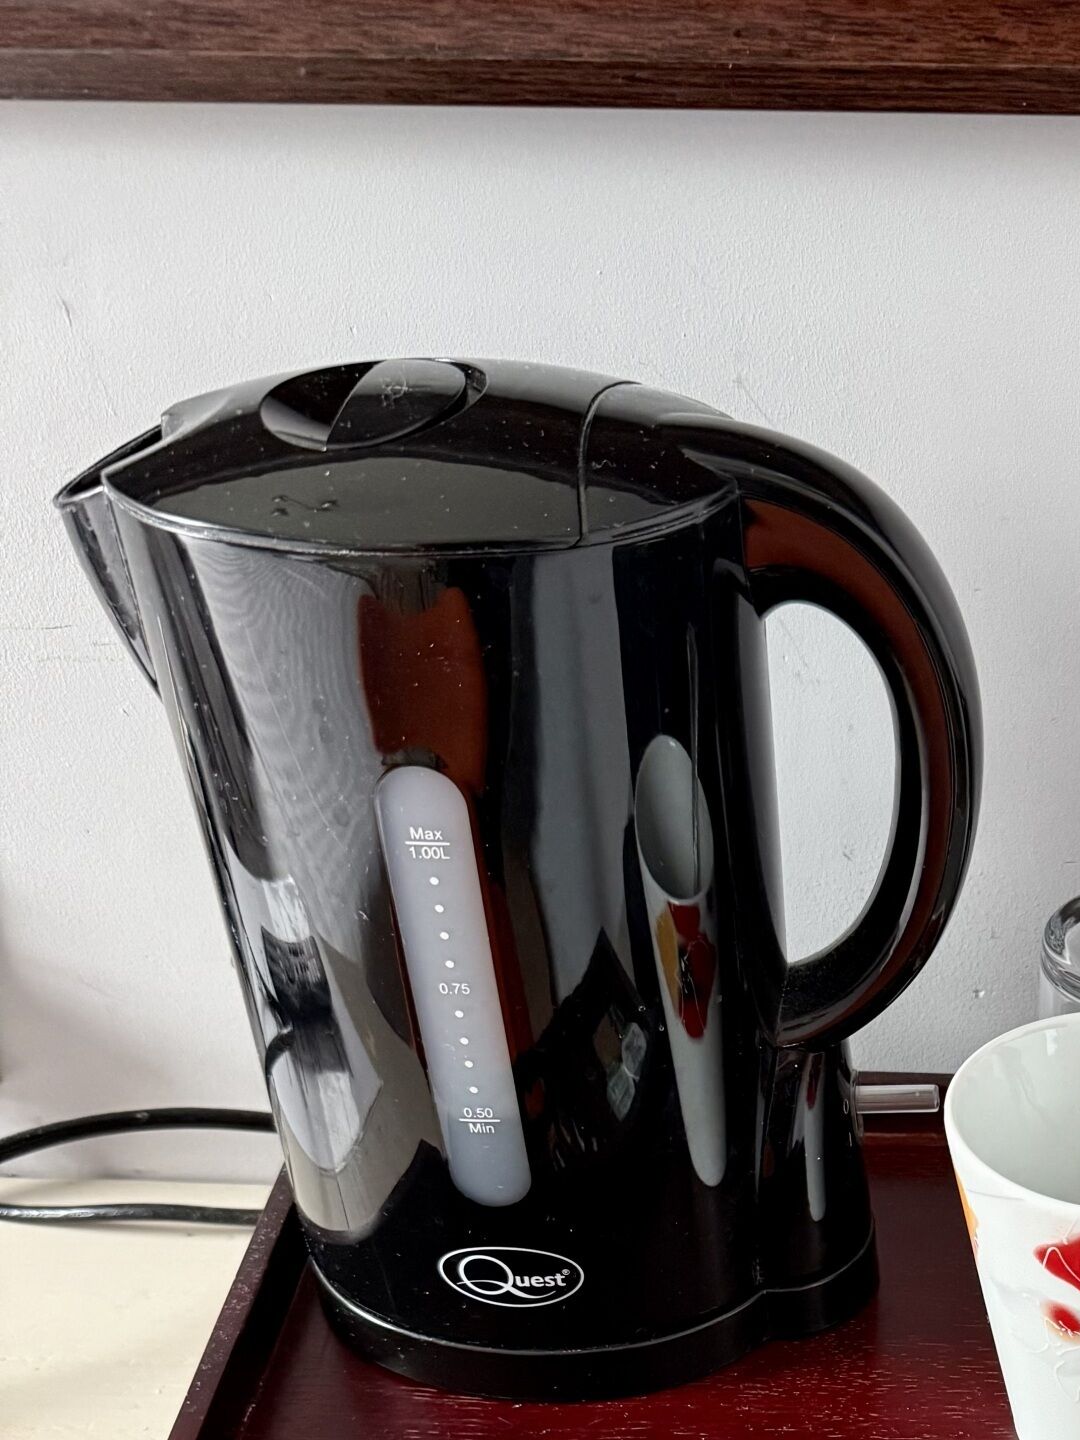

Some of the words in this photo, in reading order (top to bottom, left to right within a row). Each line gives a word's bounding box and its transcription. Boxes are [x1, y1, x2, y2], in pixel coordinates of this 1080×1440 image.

[409, 826, 443, 841] Max
[409, 846, 450, 859] 1.00L
[439, 982, 471, 995] 0.75
[463, 1107, 493, 1118] 0.50
[468, 1122, 495, 1134] Min
